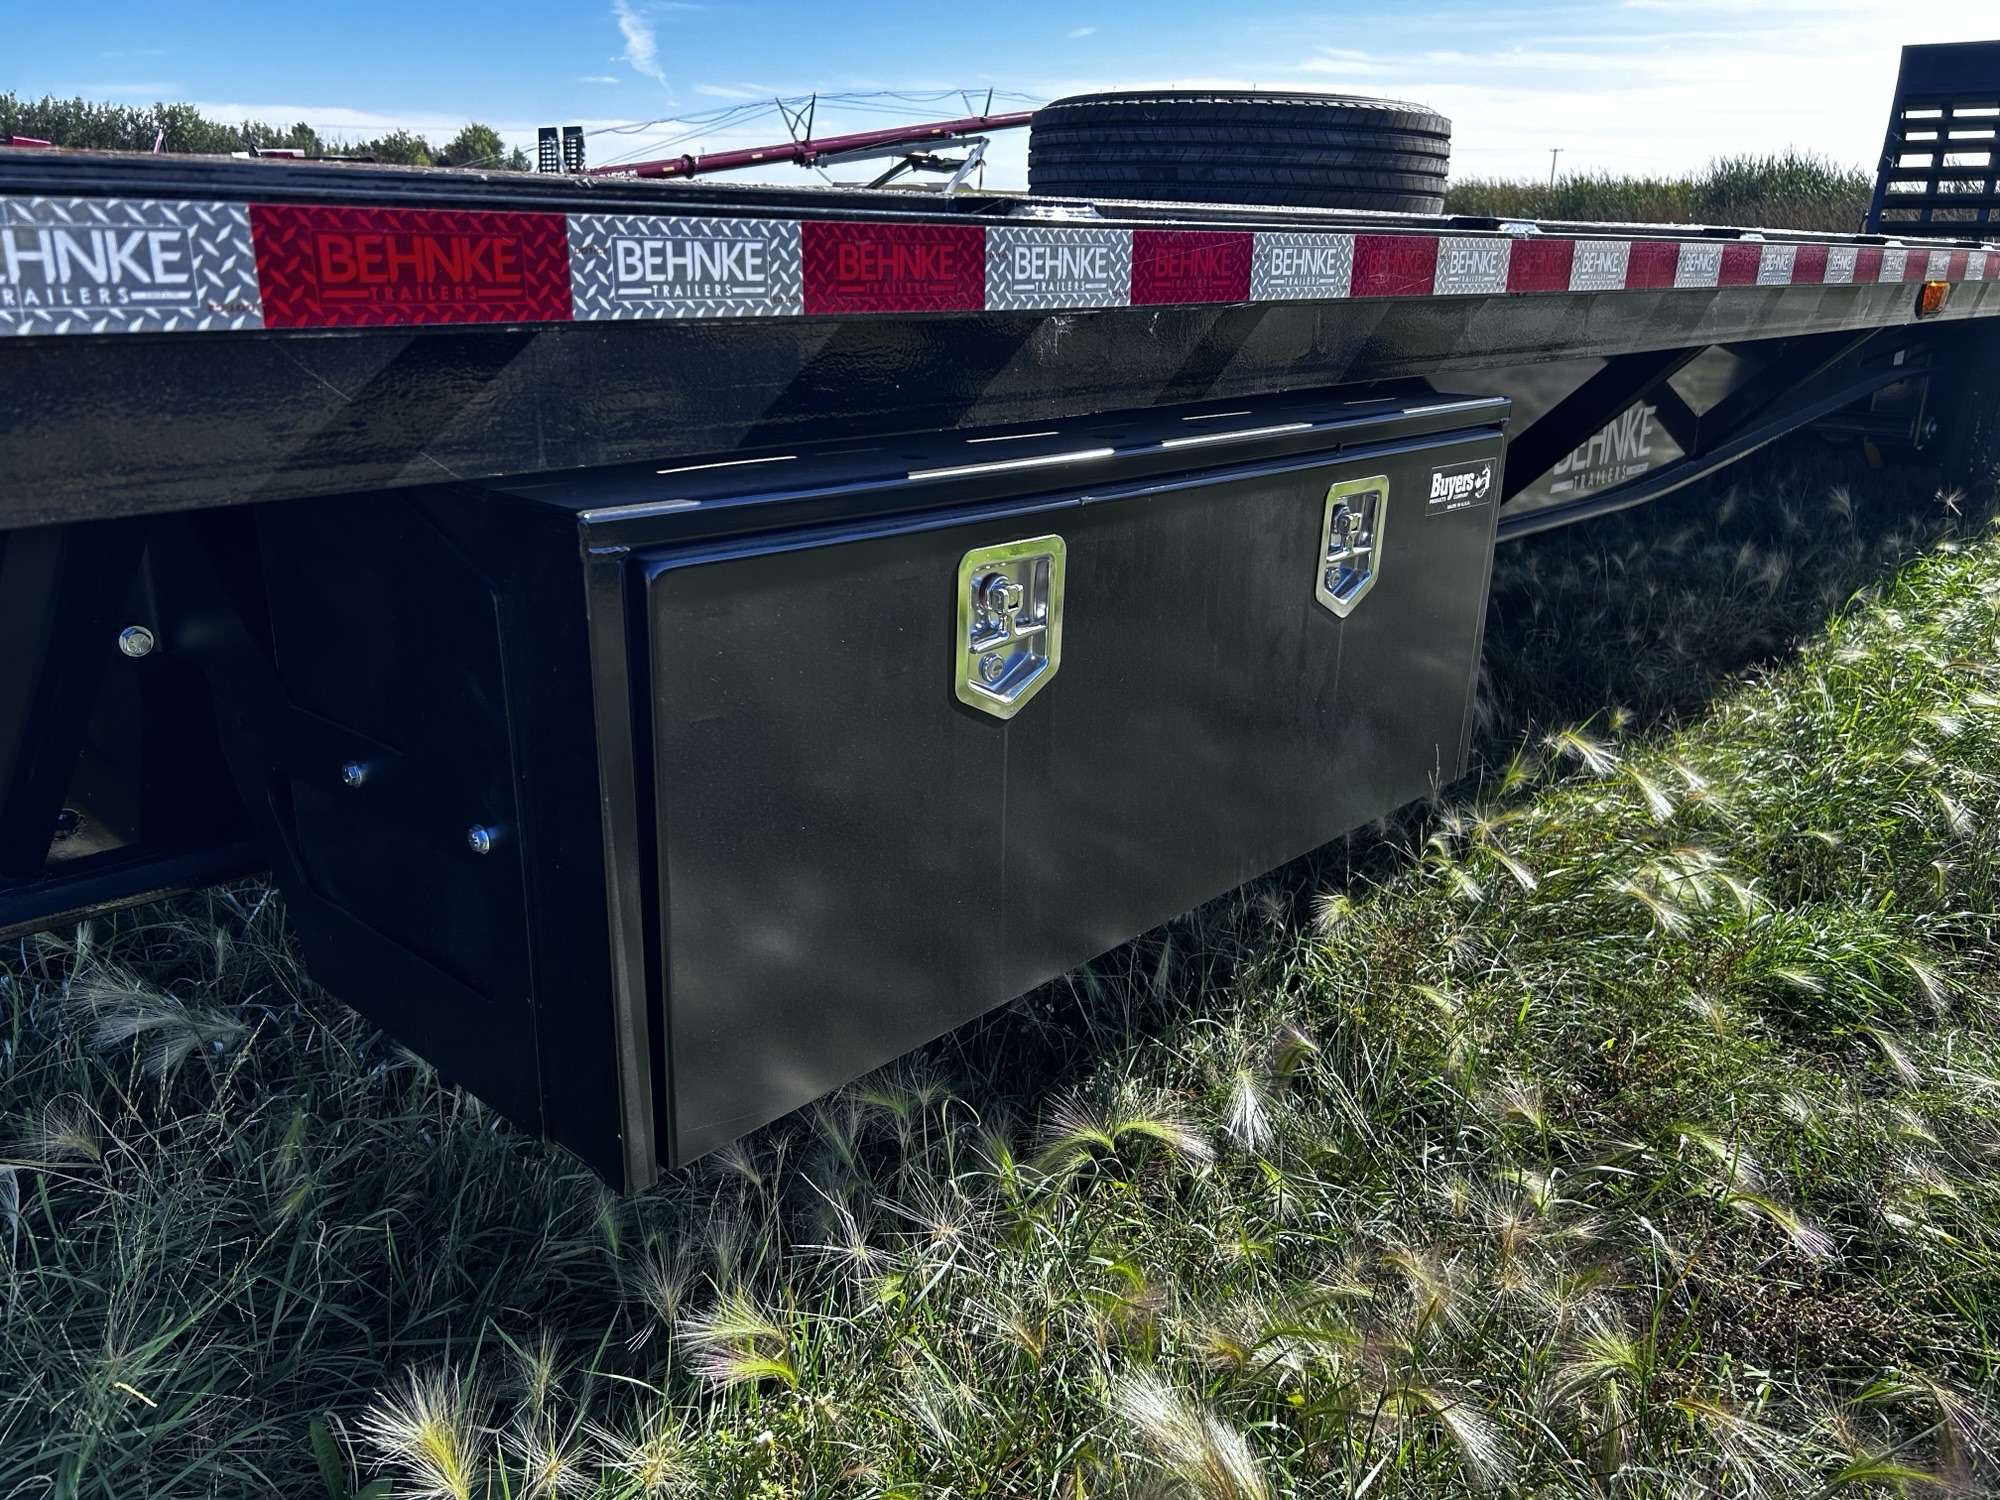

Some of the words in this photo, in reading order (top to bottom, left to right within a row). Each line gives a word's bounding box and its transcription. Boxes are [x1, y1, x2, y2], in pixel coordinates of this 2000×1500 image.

[0, 230, 189, 284] HNKE
[317, 234, 523, 283] BEHNKE
[616, 239, 766, 283] BEHNKE
[839, 243, 956, 281] BEHNKE
[1014, 247, 1108, 280] BEHNKE
[1154, 248, 1232, 278] BEHNKE
[1271, 248, 1338, 276] BEHNKE
[1449, 251, 1499, 274] BEHNKE
[1581, 252, 1619, 273] BEHNKE
[370, 286, 478, 301] TRAILERS
[652, 284, 733, 298] TRAILERS
[1034, 281, 1086, 292] TRAILERS
[1430, 472, 1475, 501] Buyers
[1574, 464, 1627, 491] TRAILERS
